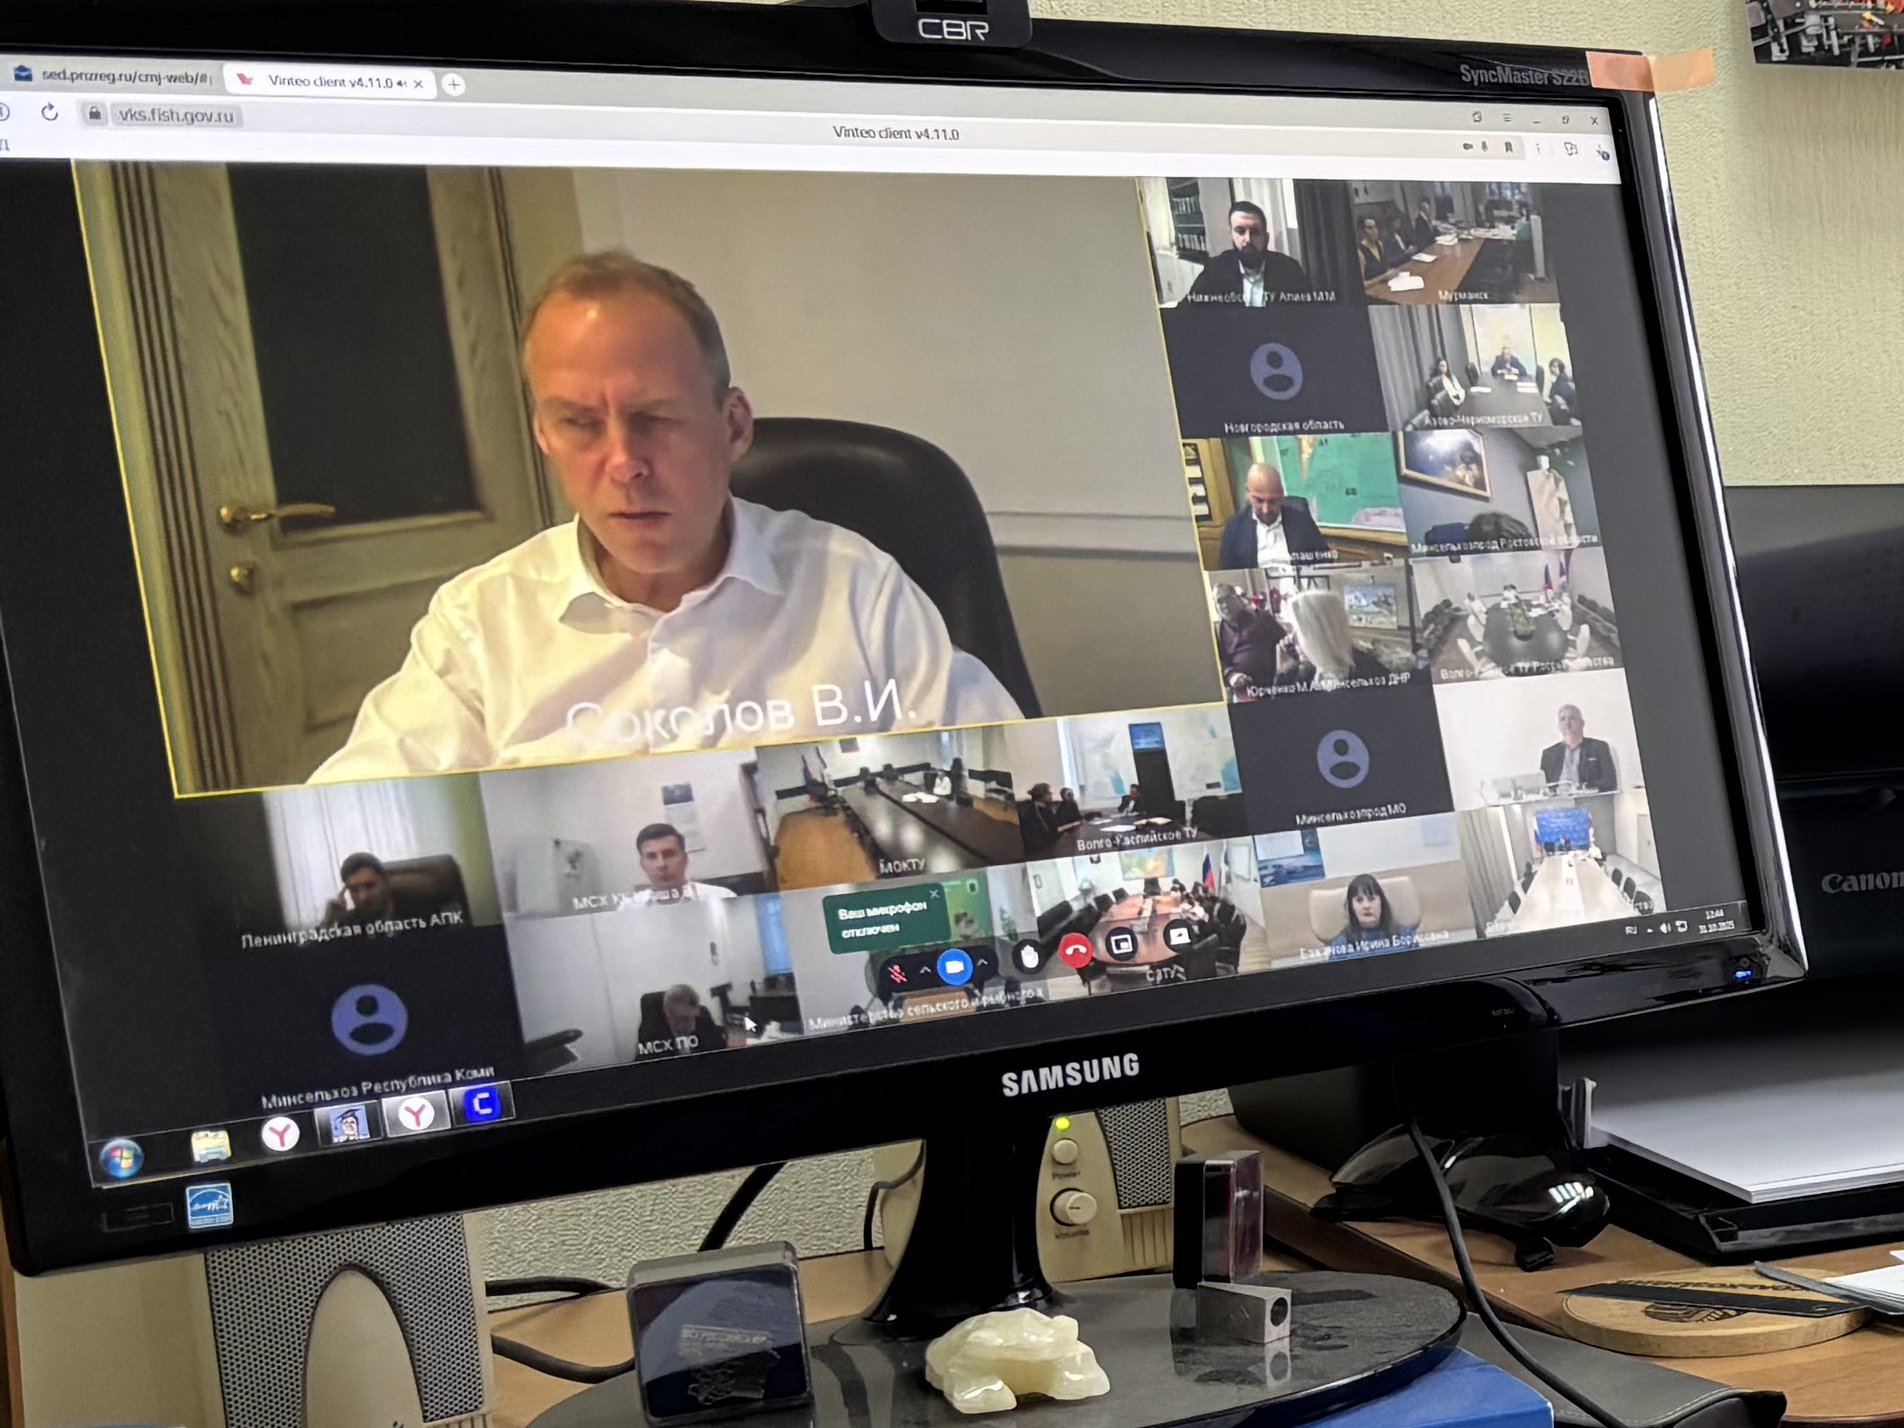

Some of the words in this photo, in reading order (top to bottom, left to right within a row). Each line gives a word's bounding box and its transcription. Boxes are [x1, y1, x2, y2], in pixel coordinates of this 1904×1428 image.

[917, 16, 990, 42] CBR
[313, 75, 347, 89] client
[349, 76, 394, 90] v4.11.0
[1459, 63, 1549, 87] SyncMaster
[878, 127, 912, 139] client
[914, 128, 960, 141] v4.11.0
[1303, 418, 1346, 432] область
[810, 678, 917, 727] В.И.
[865, 900, 928, 918] микрофон
[240, 922, 363, 950] Ленинградская
[365, 916, 426, 939] область
[429, 909, 465, 927] АПК
[1001, 1052, 1140, 1097] SAMSUNG
